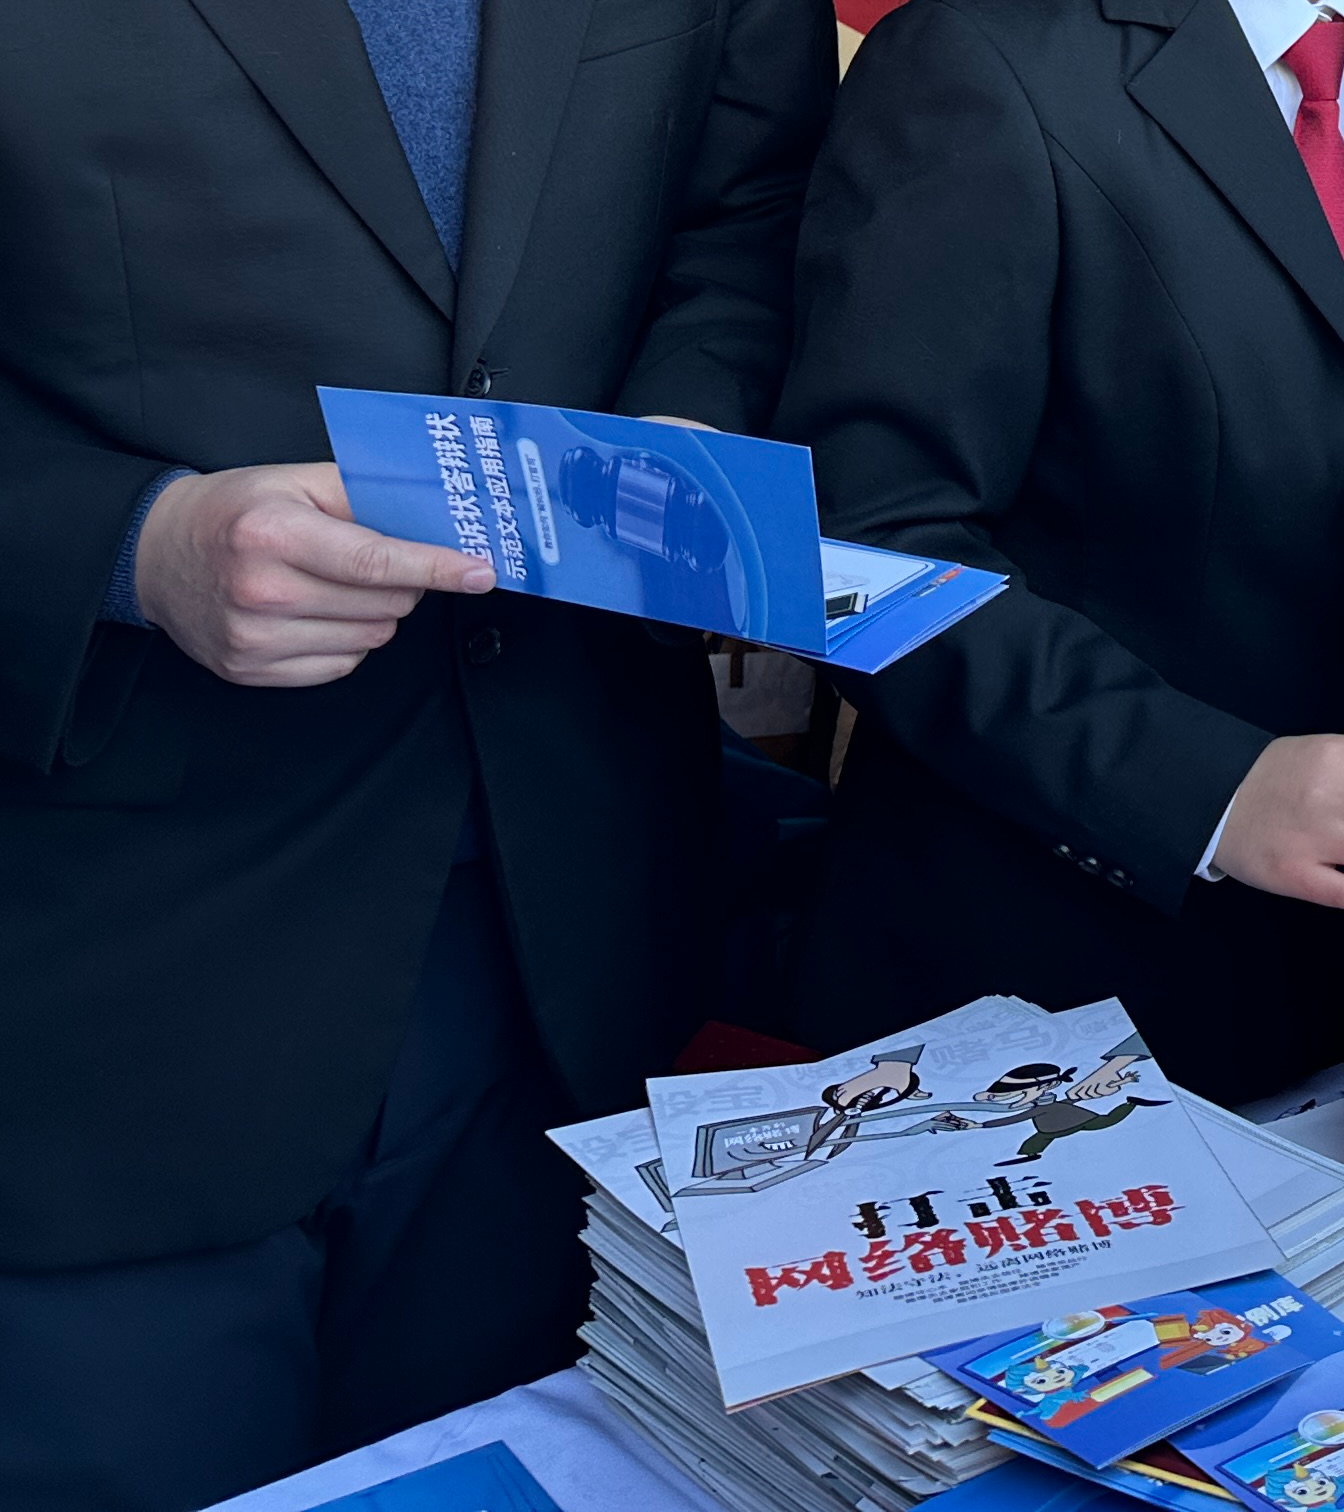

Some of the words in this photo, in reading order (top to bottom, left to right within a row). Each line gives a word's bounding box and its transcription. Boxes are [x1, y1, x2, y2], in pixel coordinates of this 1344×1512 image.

[469, 414, 528, 581] 示范文本应用指南
[744, 1184, 1187, 1308] 网络赌博
[848, 1176, 1053, 1239] 打击
